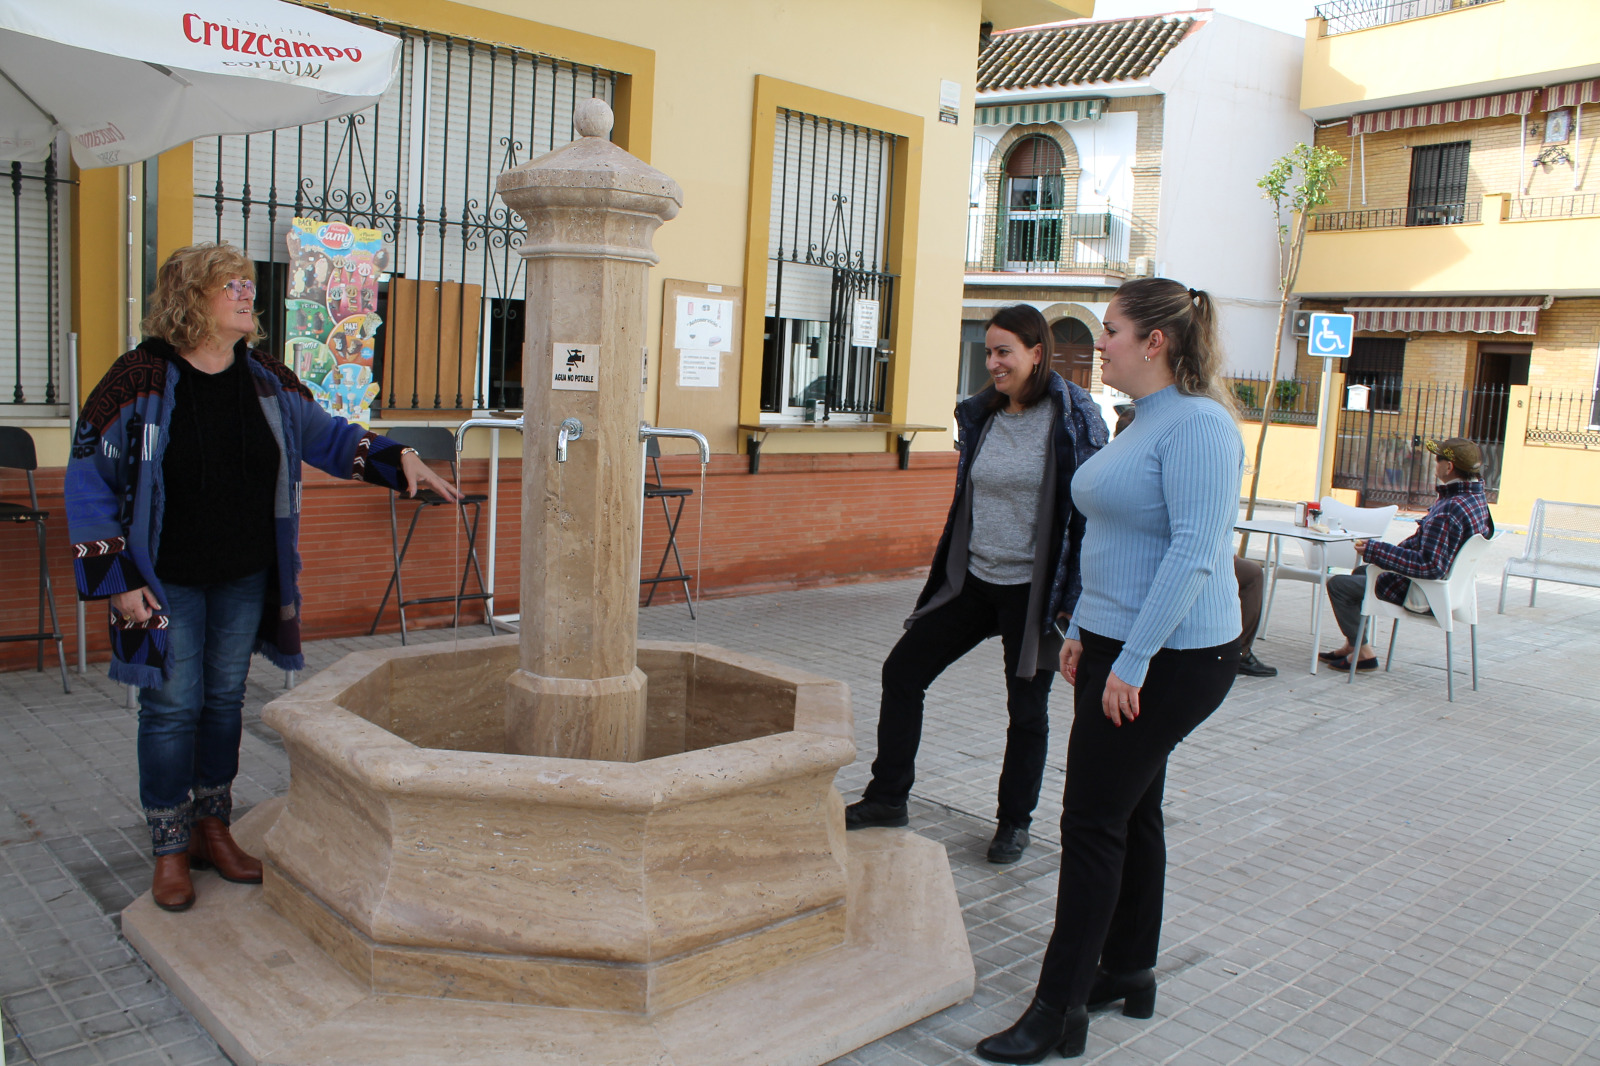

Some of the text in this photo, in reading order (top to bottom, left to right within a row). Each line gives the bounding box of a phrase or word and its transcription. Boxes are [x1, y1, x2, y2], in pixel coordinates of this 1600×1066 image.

[182, 12, 362, 63] Cruzcampo
[317, 226, 353, 247] Camy
[554, 373, 594, 383] AGUA NO POTABLE
[1516, 400, 1523, 409] 8
